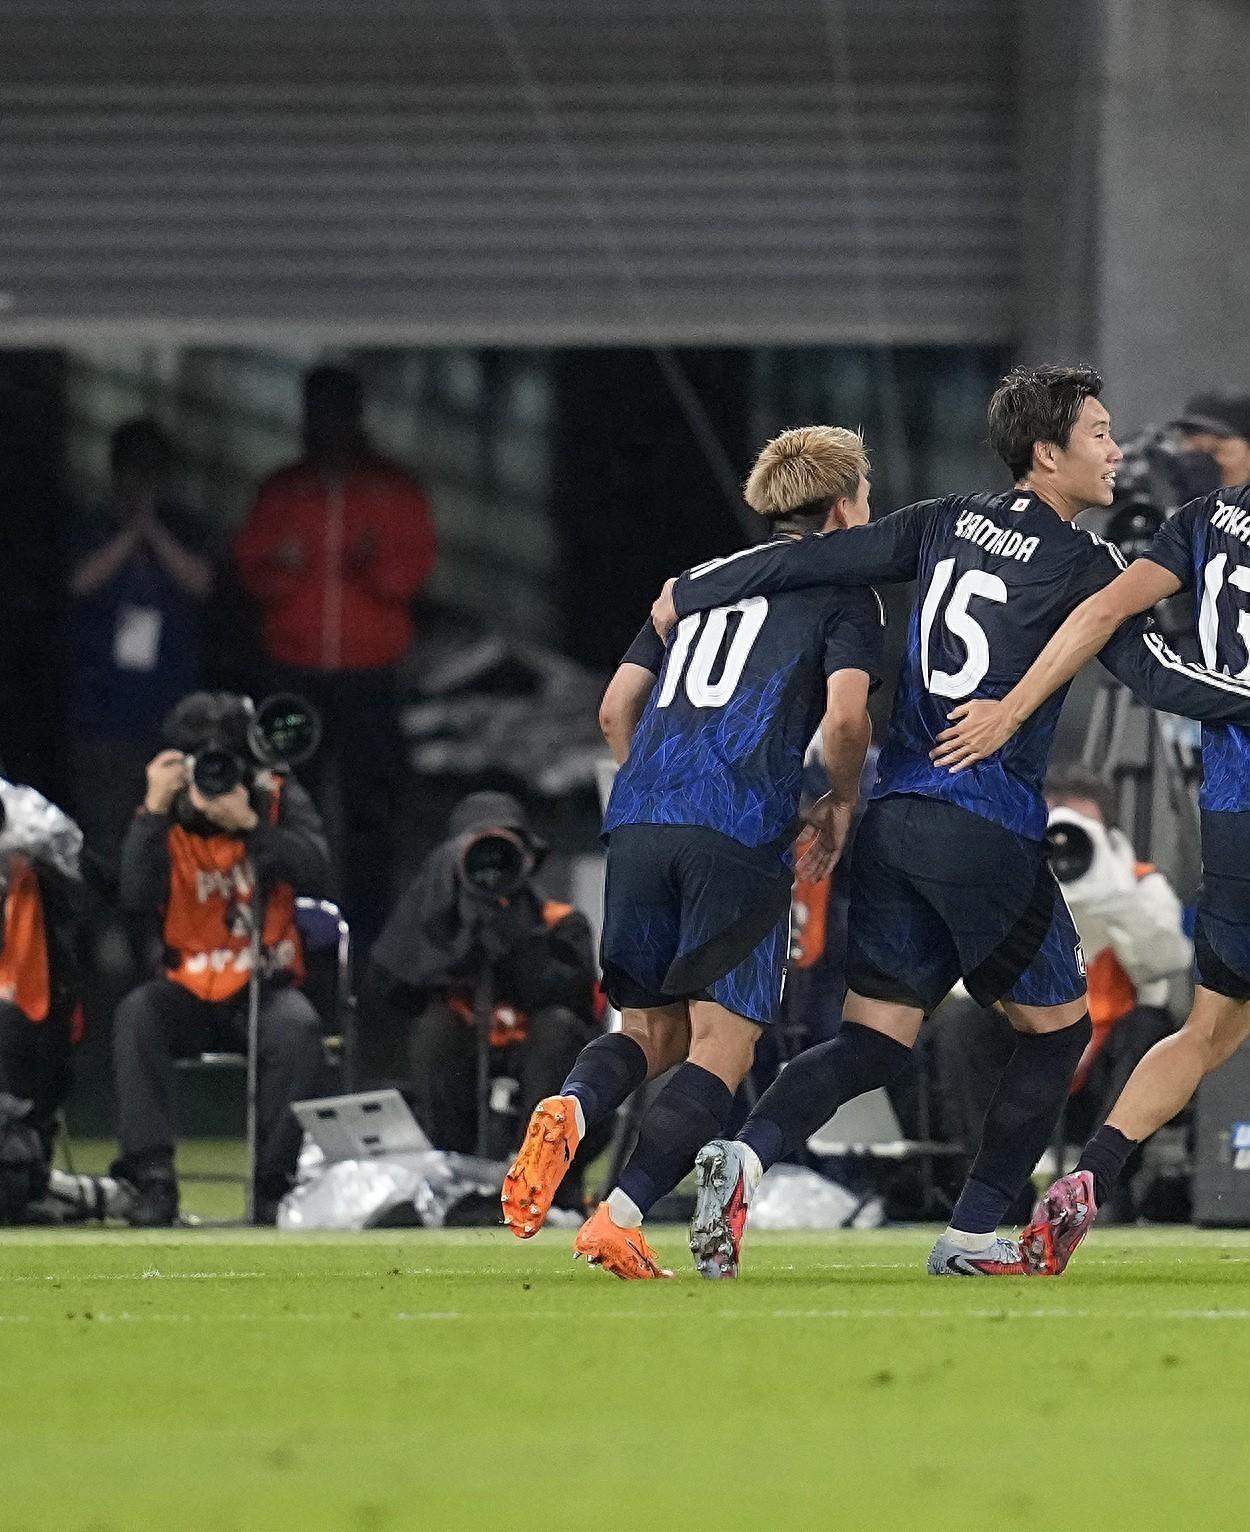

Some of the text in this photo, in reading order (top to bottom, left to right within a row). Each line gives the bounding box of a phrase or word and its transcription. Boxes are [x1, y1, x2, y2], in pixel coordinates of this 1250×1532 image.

[955, 509, 1040, 563] YAMADA
[657, 595, 769, 708] 10
[920, 557, 1008, 699] 15
